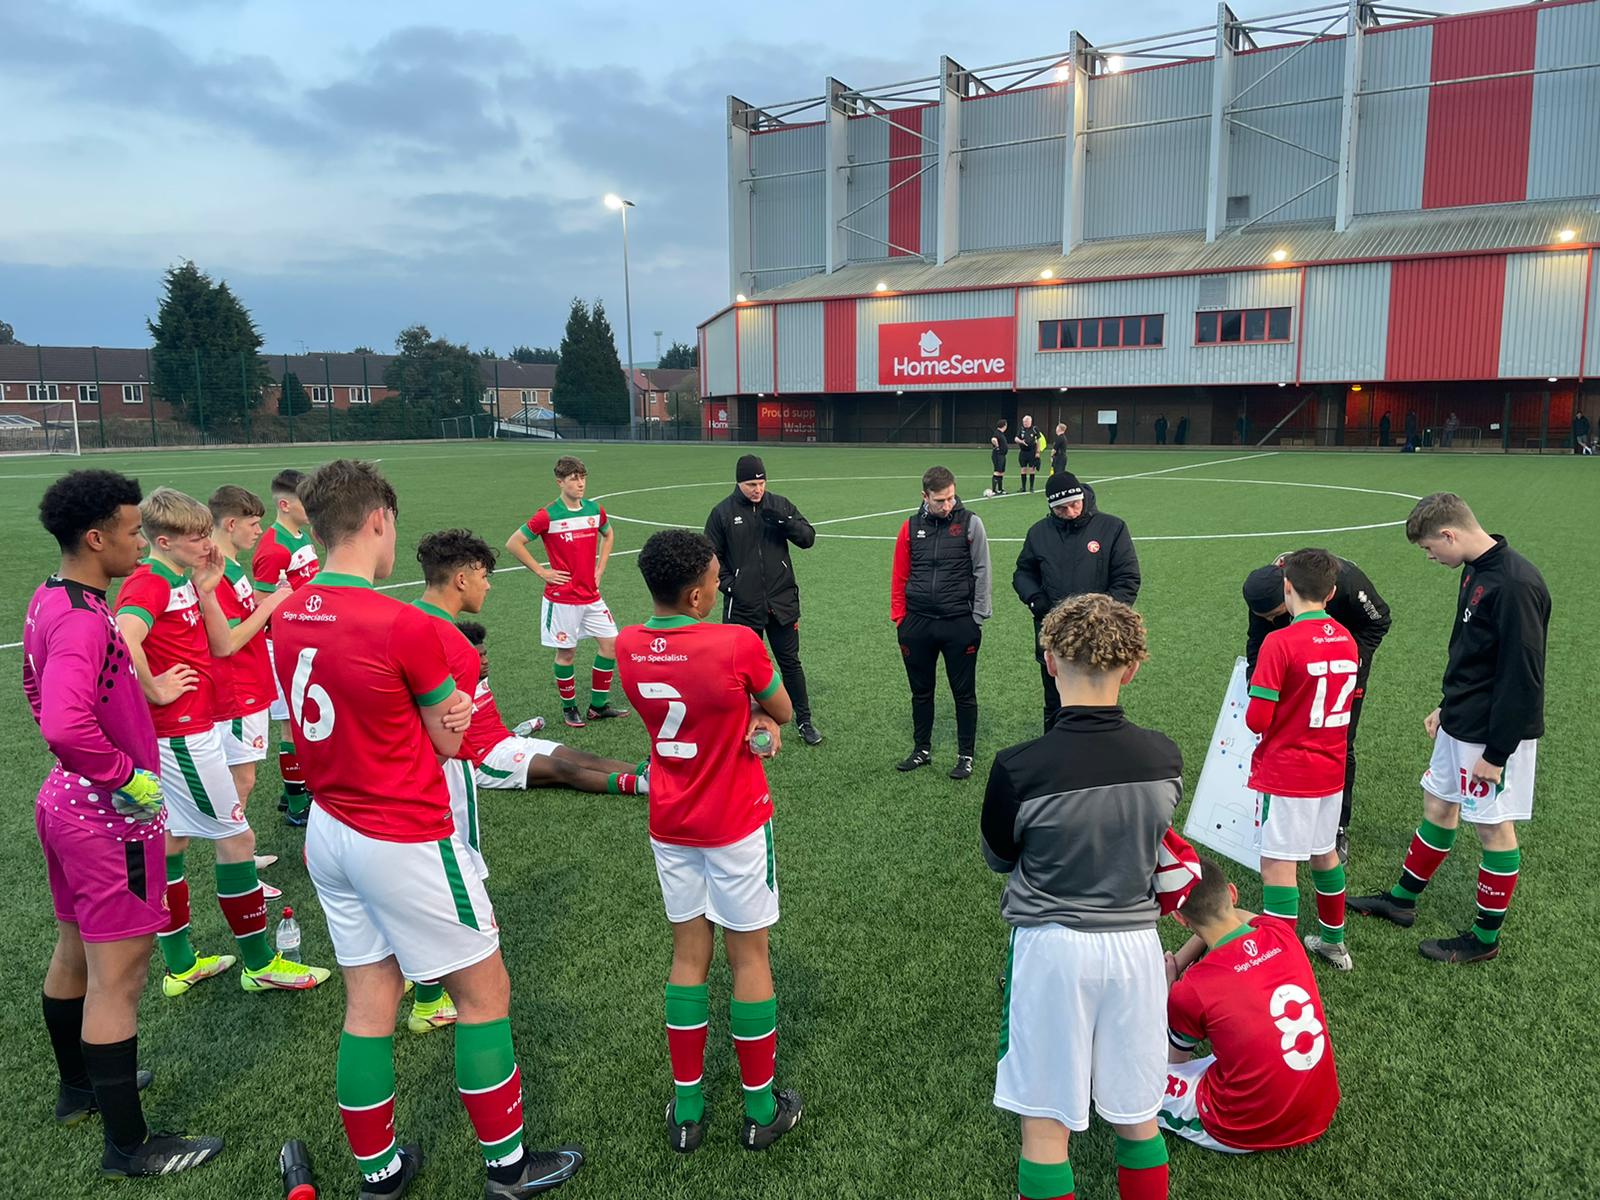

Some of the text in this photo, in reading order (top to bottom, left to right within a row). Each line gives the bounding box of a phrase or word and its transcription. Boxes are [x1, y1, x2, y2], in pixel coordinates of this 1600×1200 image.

[894, 354, 1005, 376] HomeServe
[761, 407, 790, 418] Proud
[282, 611, 337, 622] Sign Specialists
[631, 653, 688, 663] Sign Specialists
[291, 647, 336, 742] 6
[1307, 659, 1358, 728] 12
[637, 682, 698, 759] 2
[1233, 947, 1282, 973] Sign Specialists
[1269, 983, 1326, 1072] 8
